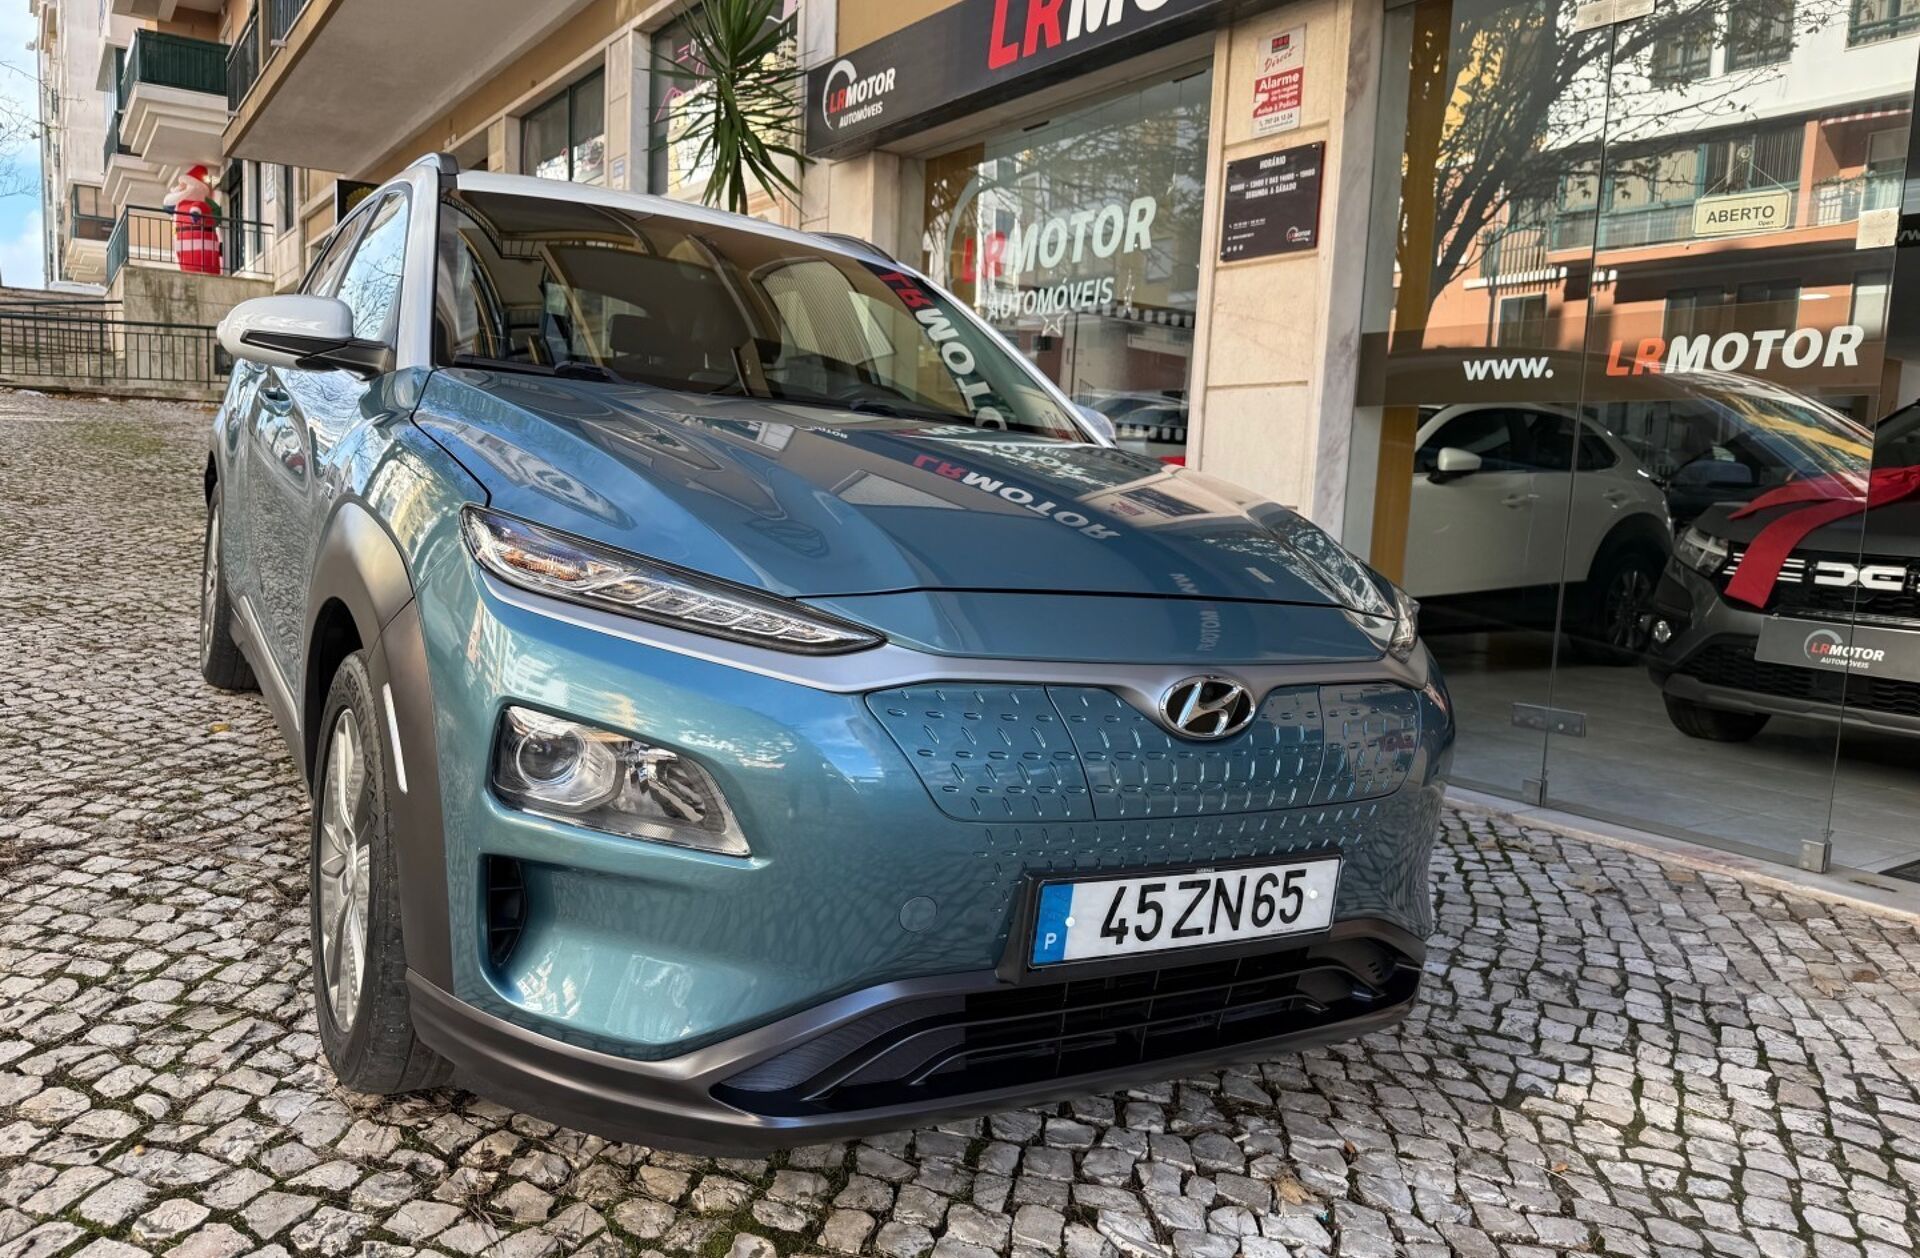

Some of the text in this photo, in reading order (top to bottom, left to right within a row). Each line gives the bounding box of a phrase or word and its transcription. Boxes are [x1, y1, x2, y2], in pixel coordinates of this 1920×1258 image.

[829, 67, 896, 113] LRMOTOR
[1259, 72, 1299, 92] Alarme
[839, 101, 883, 128] AUTOMÓVEIS
[1260, 155, 1286, 169] HORÁRIO
[1706, 204, 1775, 225] ABERTO
[961, 195, 1157, 283] LRMOTOR
[986, 277, 1115, 322] AUTOMÓVEIS
[1605, 325, 1865, 377] LRMOTOR
[1810, 642, 1885, 662] LRMOTOR
[1044, 932, 1057, 950] P
